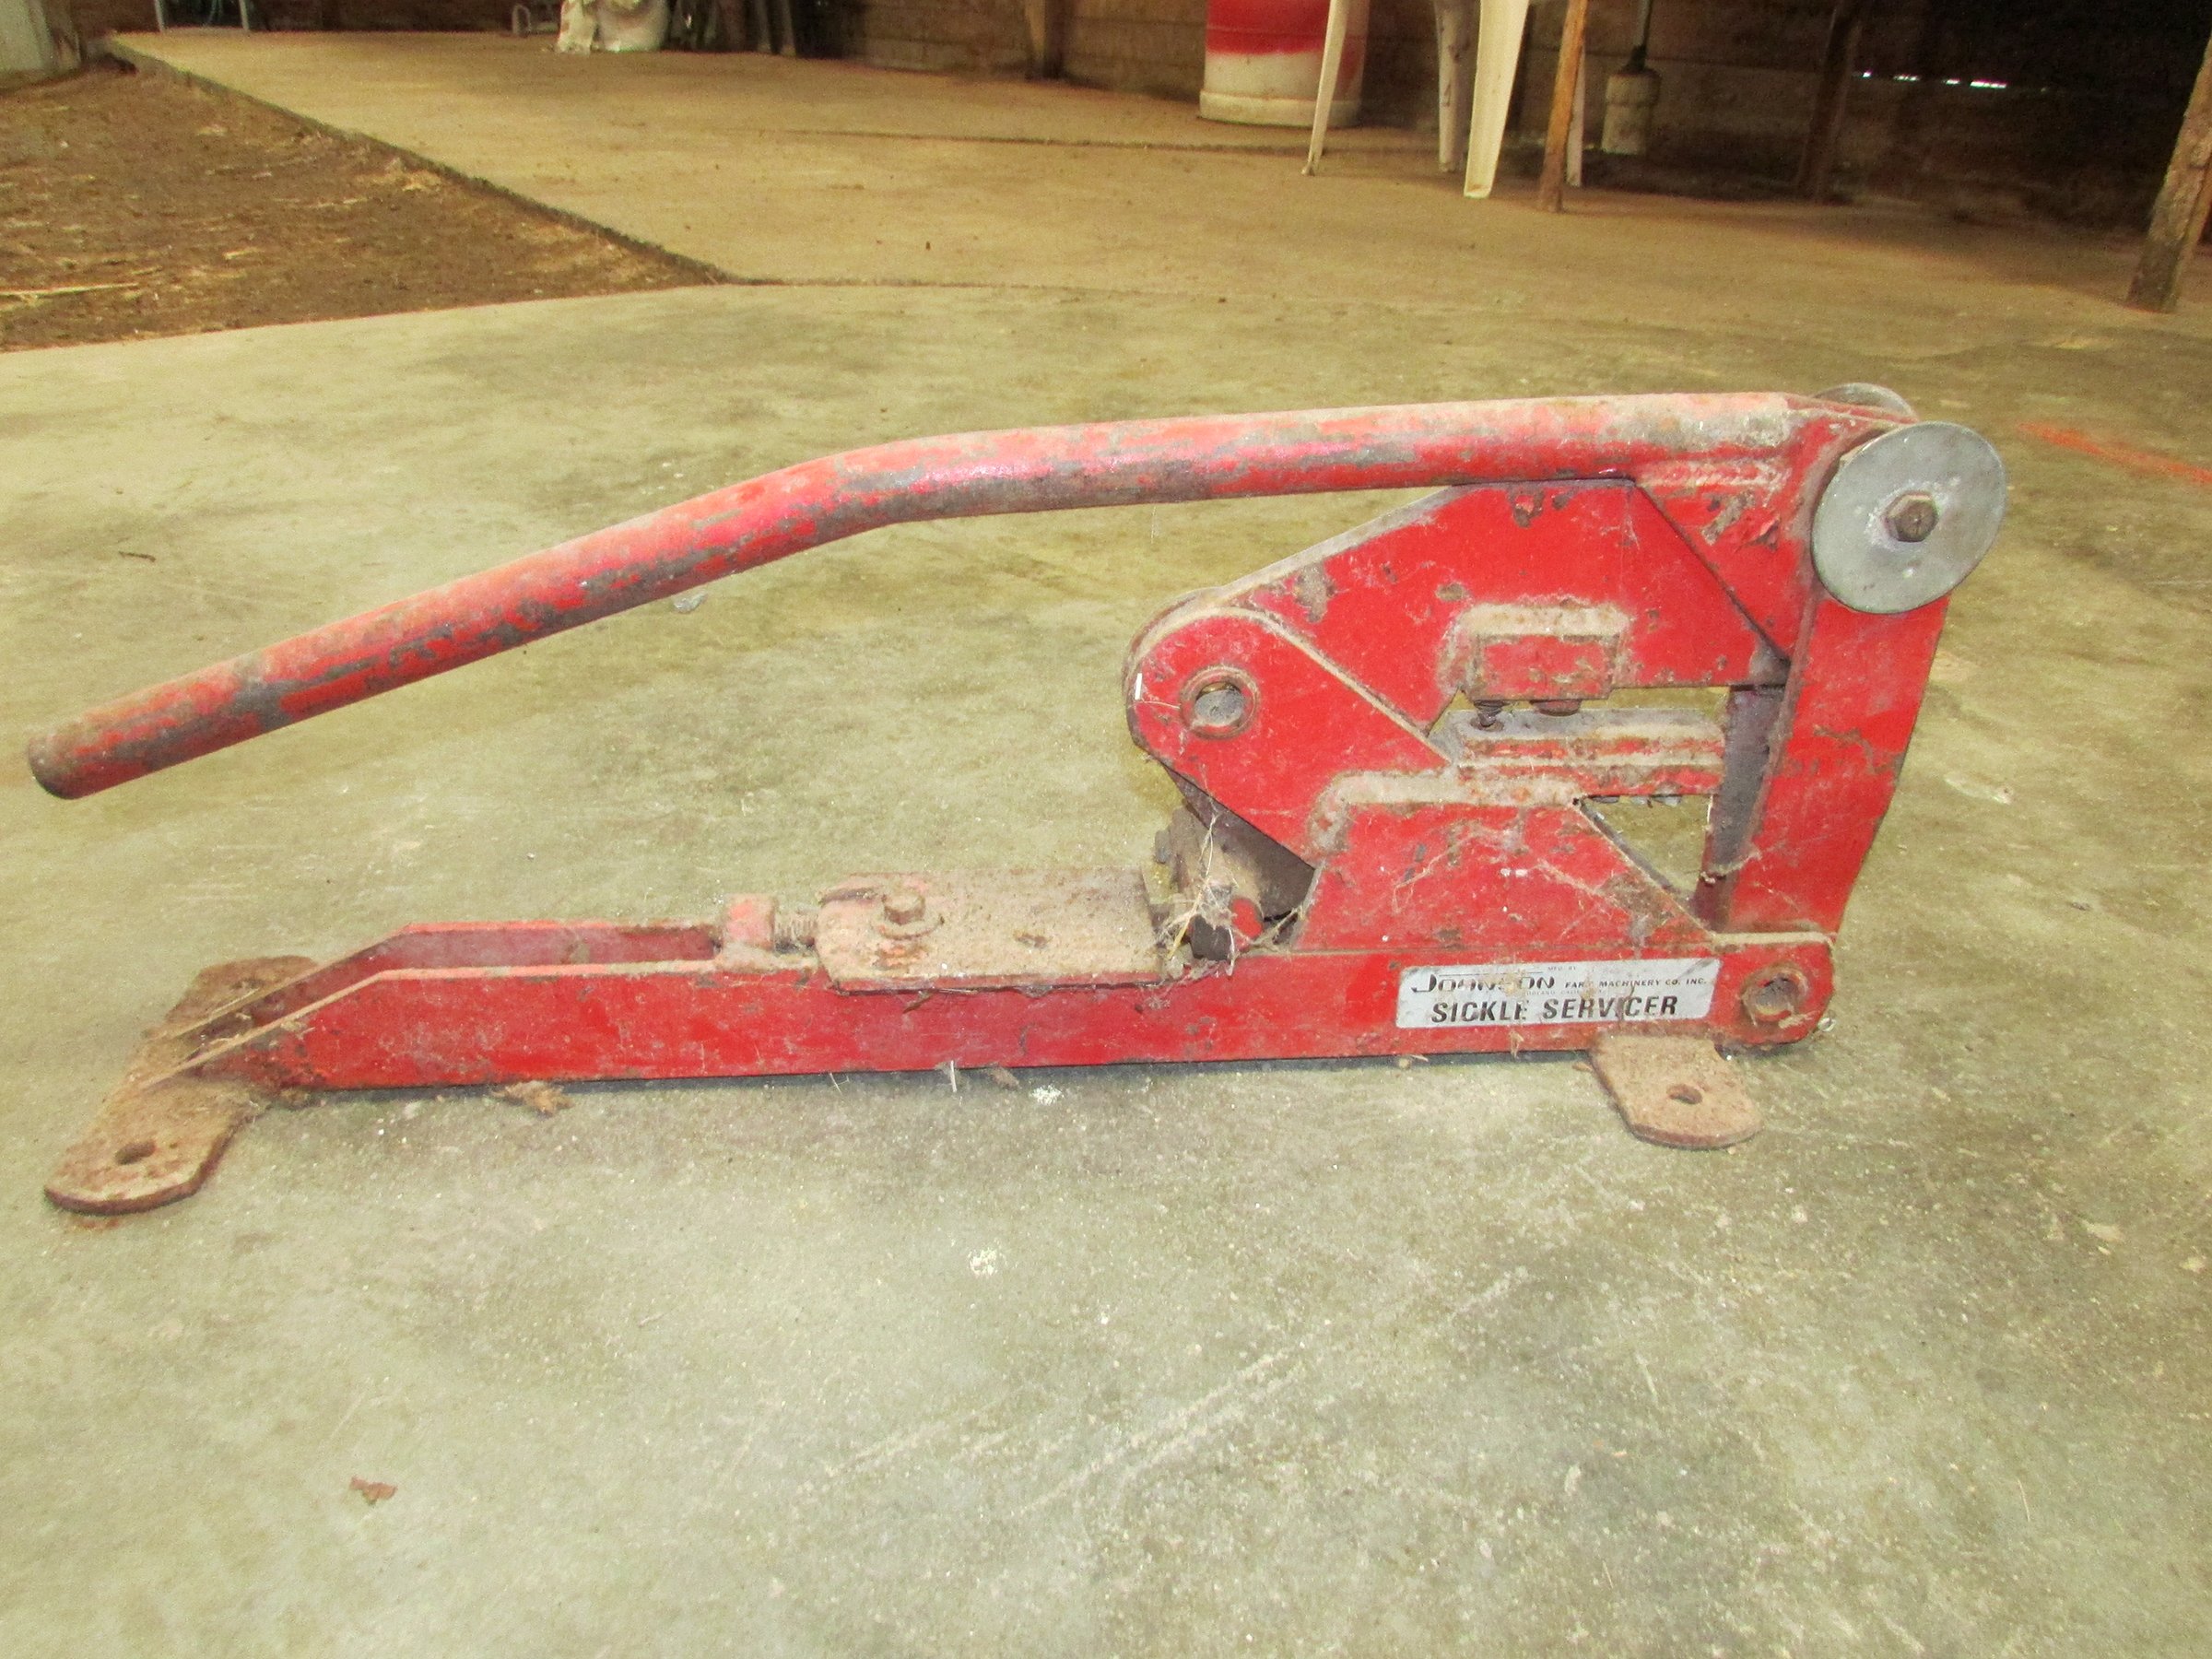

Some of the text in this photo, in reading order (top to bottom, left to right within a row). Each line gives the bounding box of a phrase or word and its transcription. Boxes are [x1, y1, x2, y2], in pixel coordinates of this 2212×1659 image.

[1411, 973, 1555, 994] JOHNON
[1565, 981, 1593, 989] FAR
[1599, 979, 1660, 988] MACHINERY
[1686, 977, 1707, 985] INC.
[1430, 994, 1678, 1023] SICKLE SERVICER
